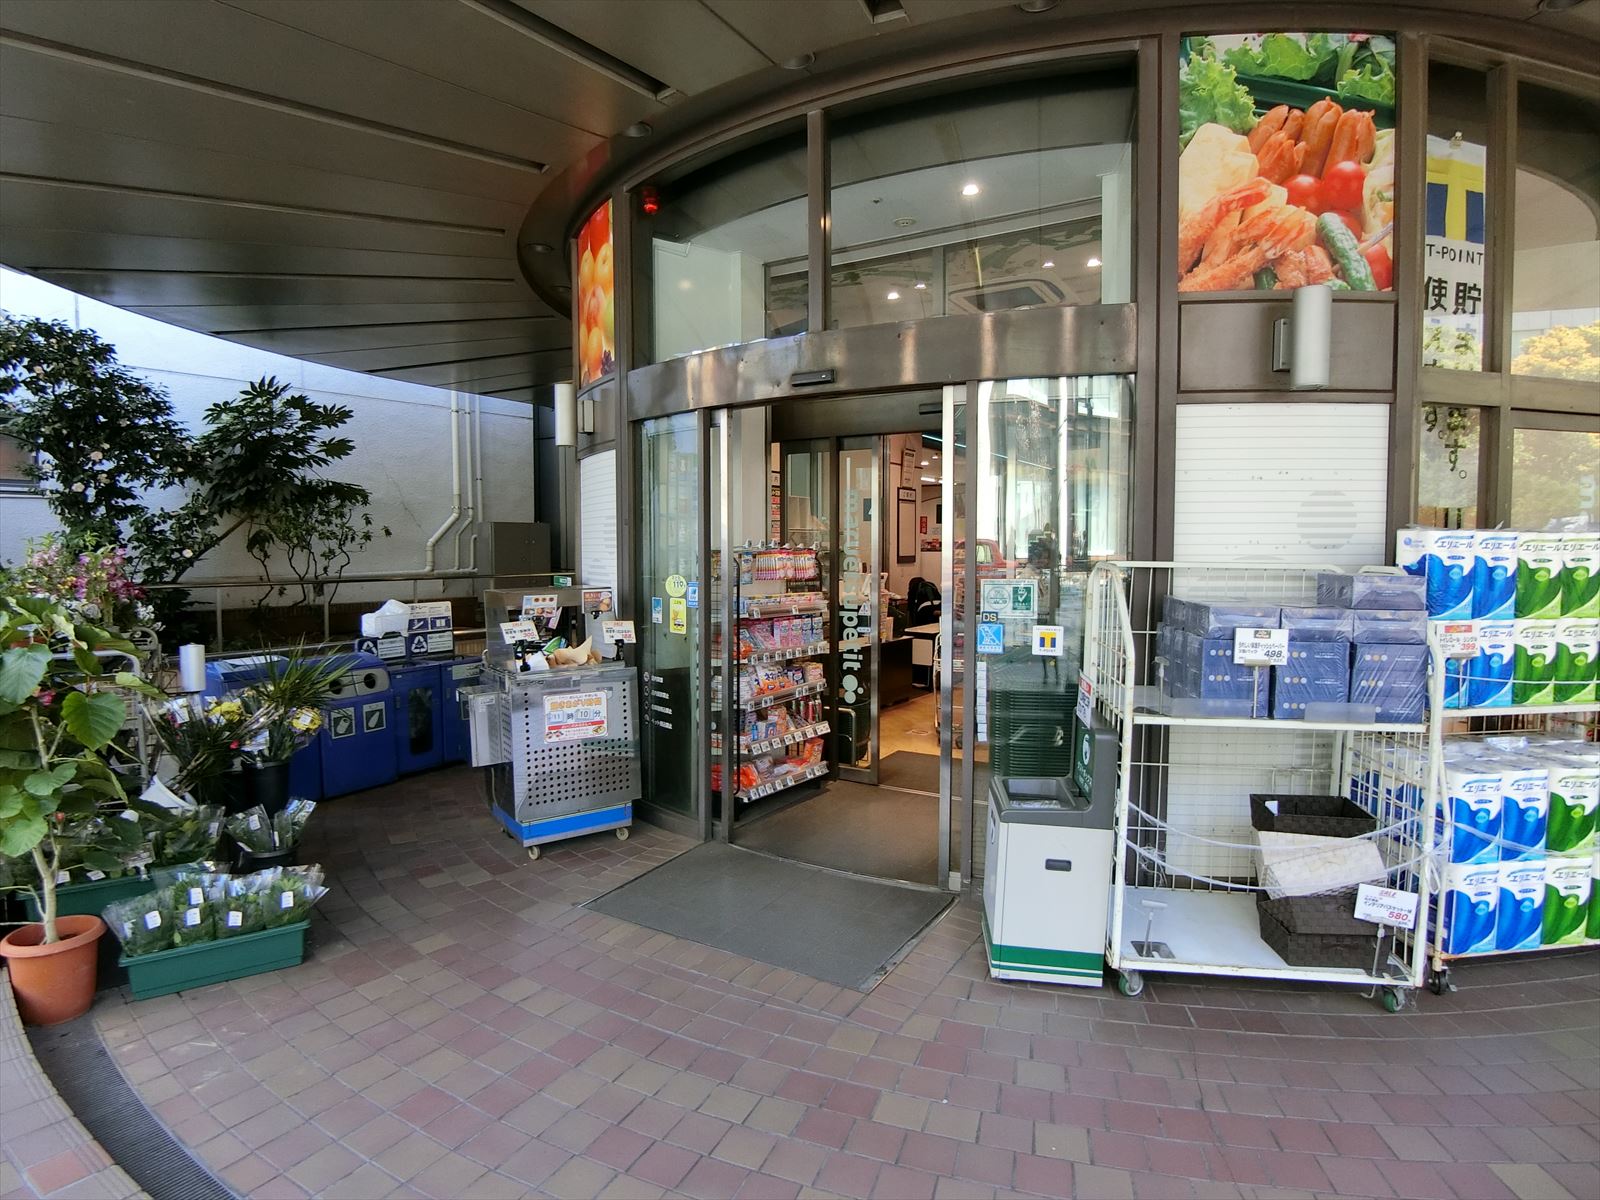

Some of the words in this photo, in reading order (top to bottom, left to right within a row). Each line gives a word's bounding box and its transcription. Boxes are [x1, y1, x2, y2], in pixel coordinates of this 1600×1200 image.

[1426, 243, 1483, 265] T-POINT
[982, 613, 998, 622] DS
[1264, 650, 1282, 658] 498
[580, 710, 589, 718] 10
[1388, 911, 1409, 921] 580
